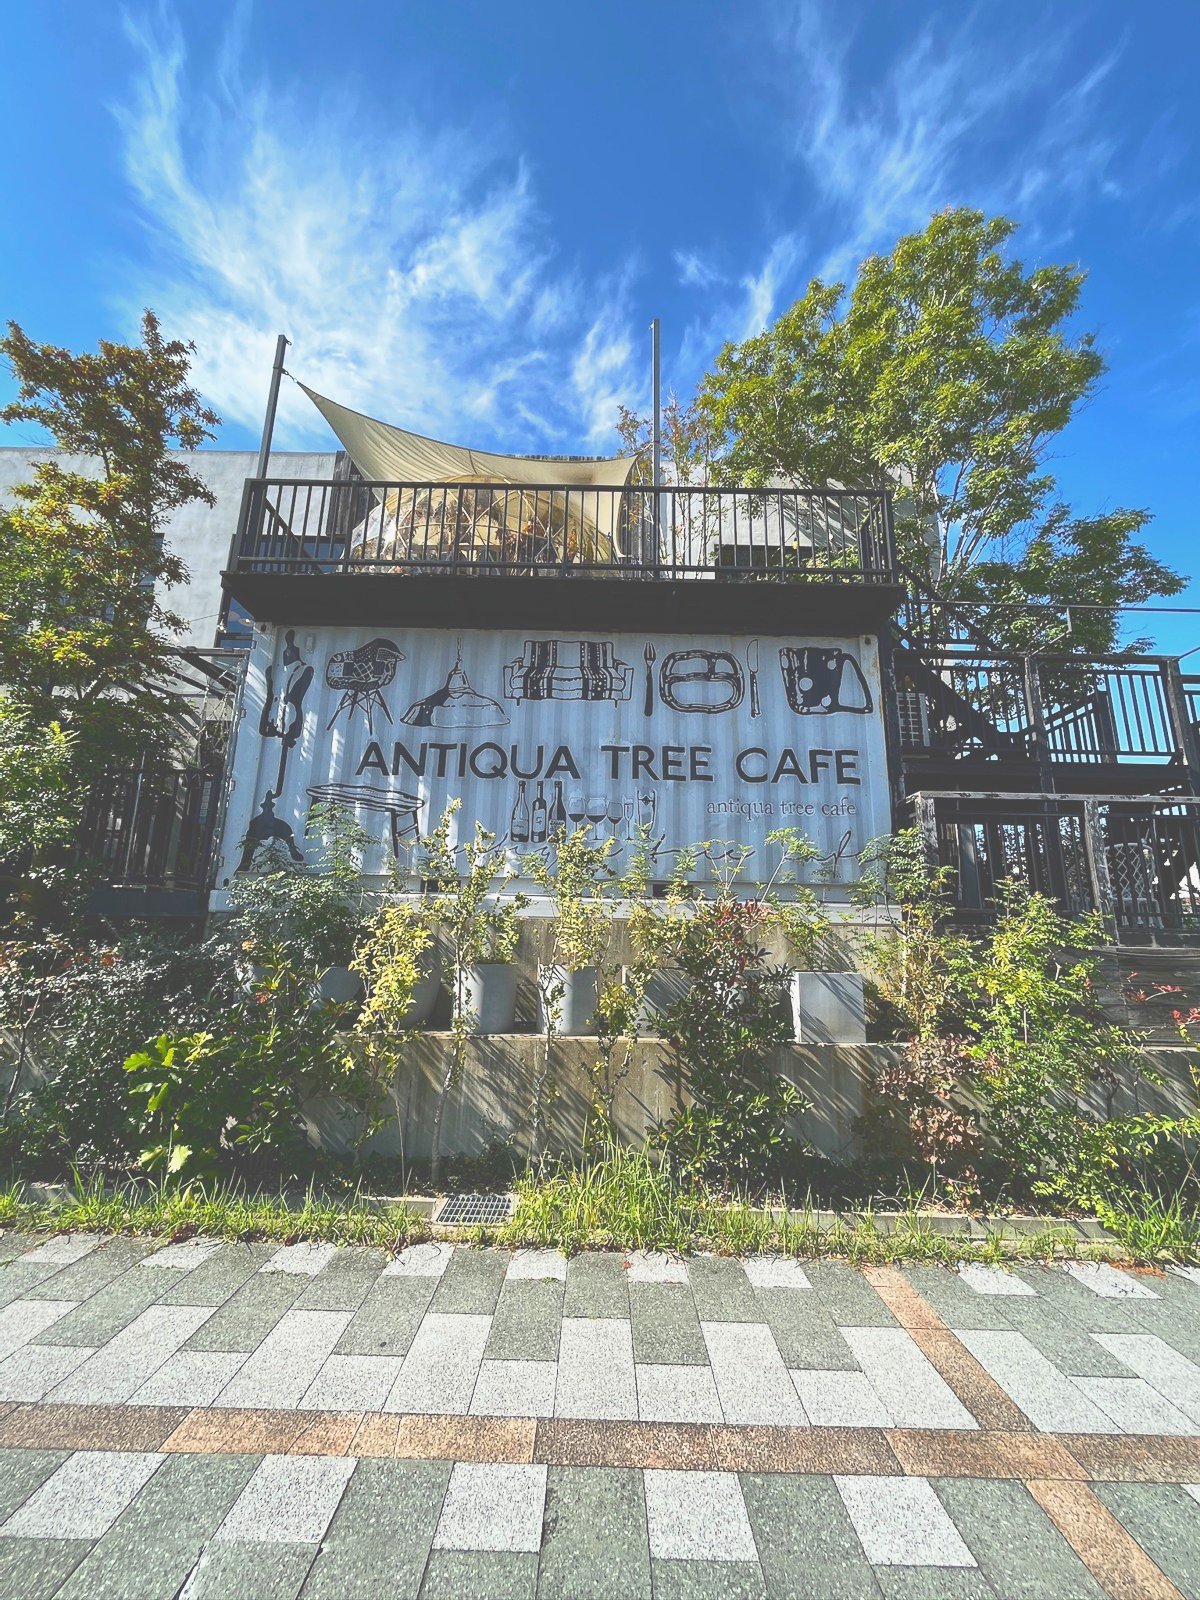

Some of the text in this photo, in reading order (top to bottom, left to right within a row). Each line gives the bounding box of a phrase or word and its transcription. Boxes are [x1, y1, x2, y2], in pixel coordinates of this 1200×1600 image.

[355, 741, 862, 786] ANTIQUA TREE CAFE
[706, 796, 857, 821] antiqua tree cafe
